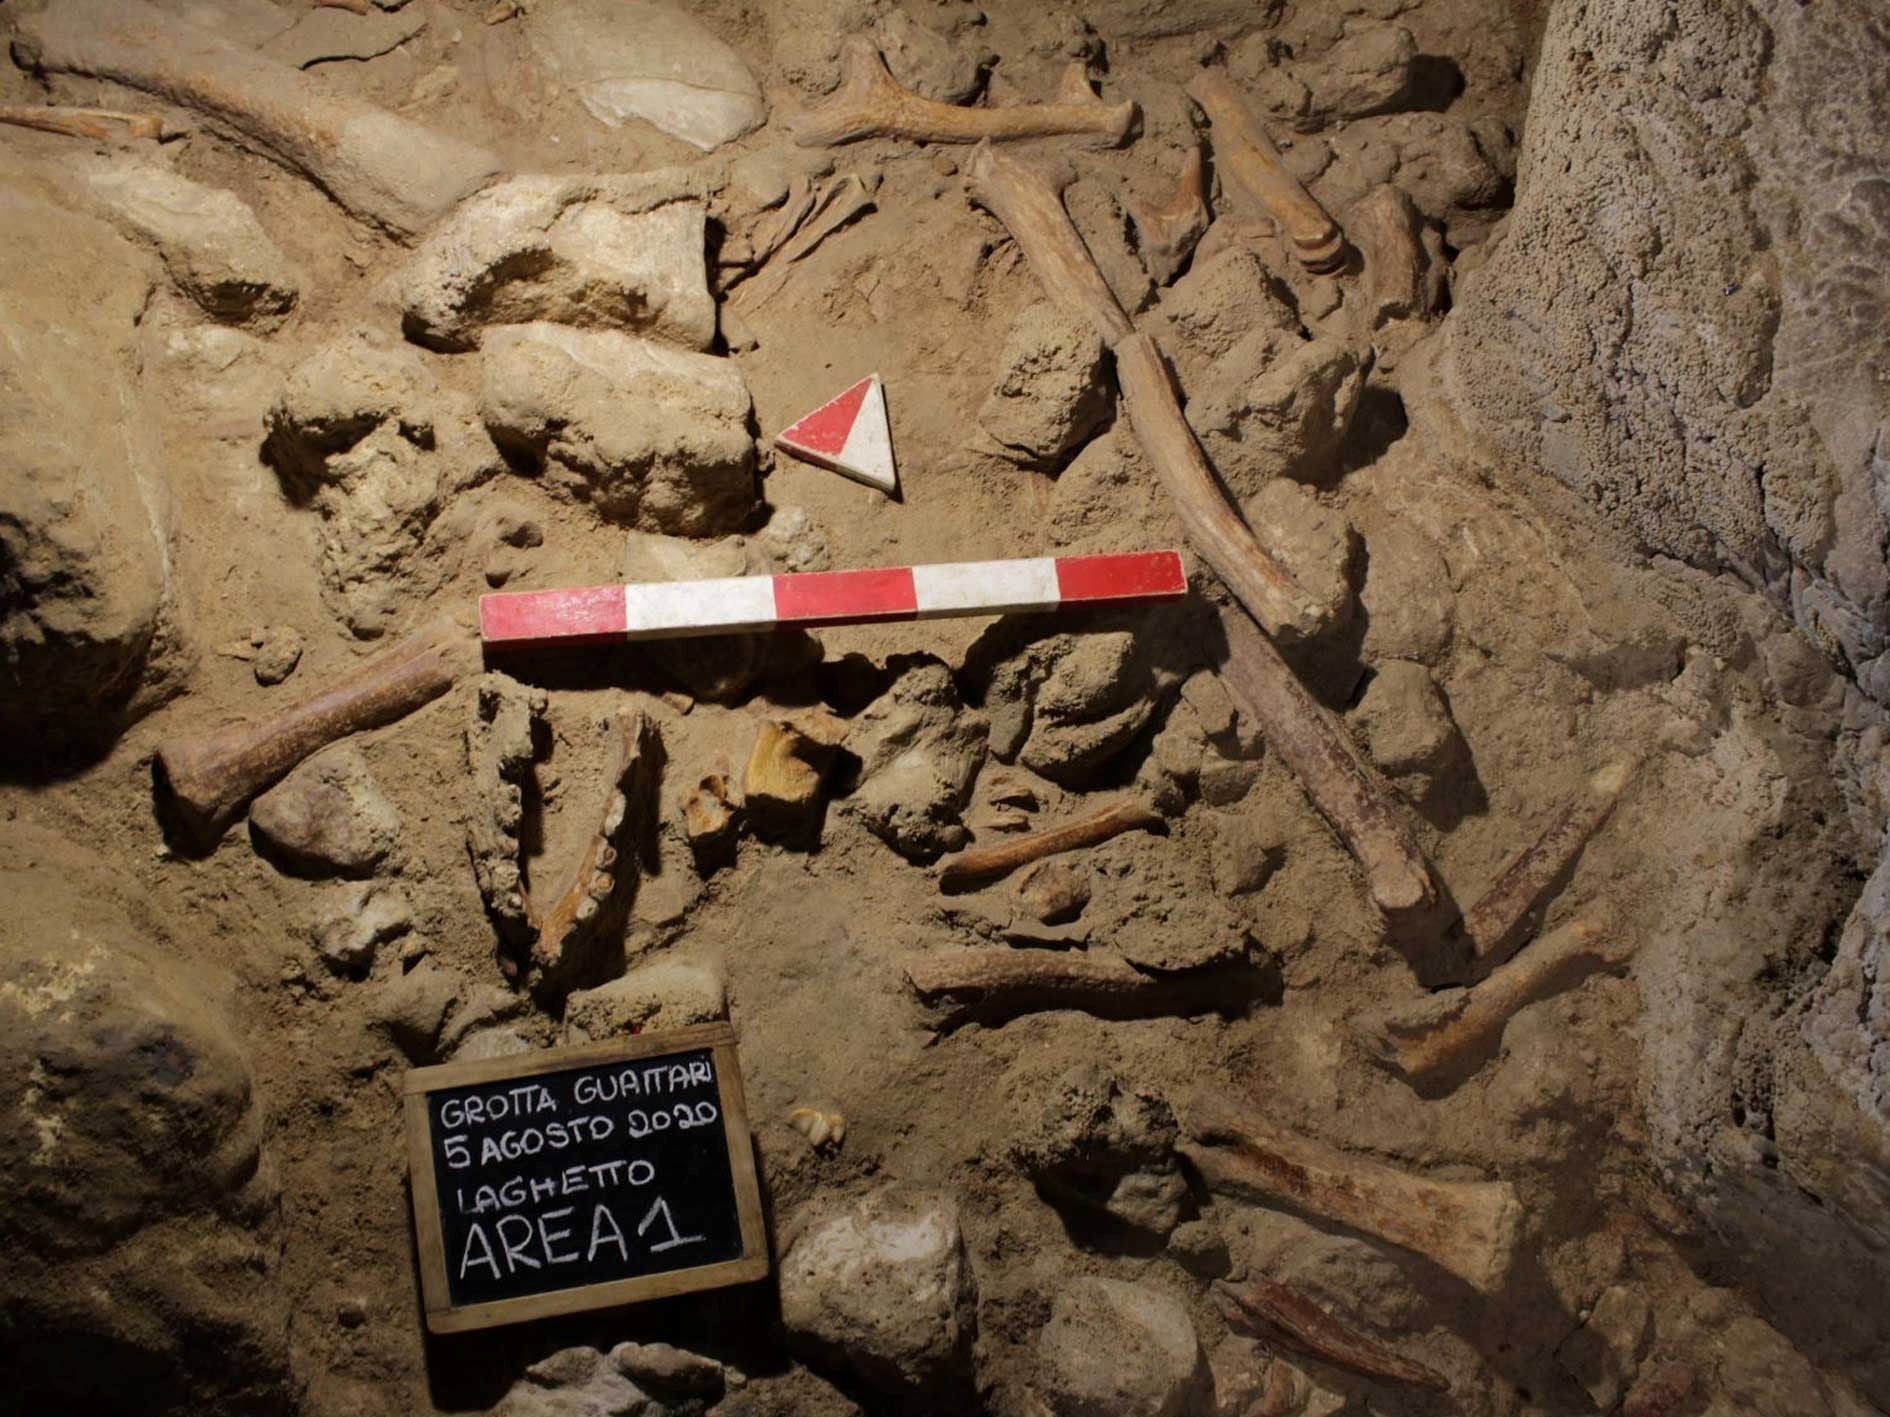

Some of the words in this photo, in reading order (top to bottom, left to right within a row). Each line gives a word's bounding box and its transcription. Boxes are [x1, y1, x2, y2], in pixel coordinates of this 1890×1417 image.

[440, 1085, 557, 1129] GROTTA
[444, 1134, 471, 1169] 5
[480, 1115, 614, 1166] AGOSTO
[628, 1101, 718, 1139] 2020
[457, 1159, 656, 1215] LAGHETTO
[460, 1205, 629, 1280] AREA
[637, 1196, 707, 1253] 1
